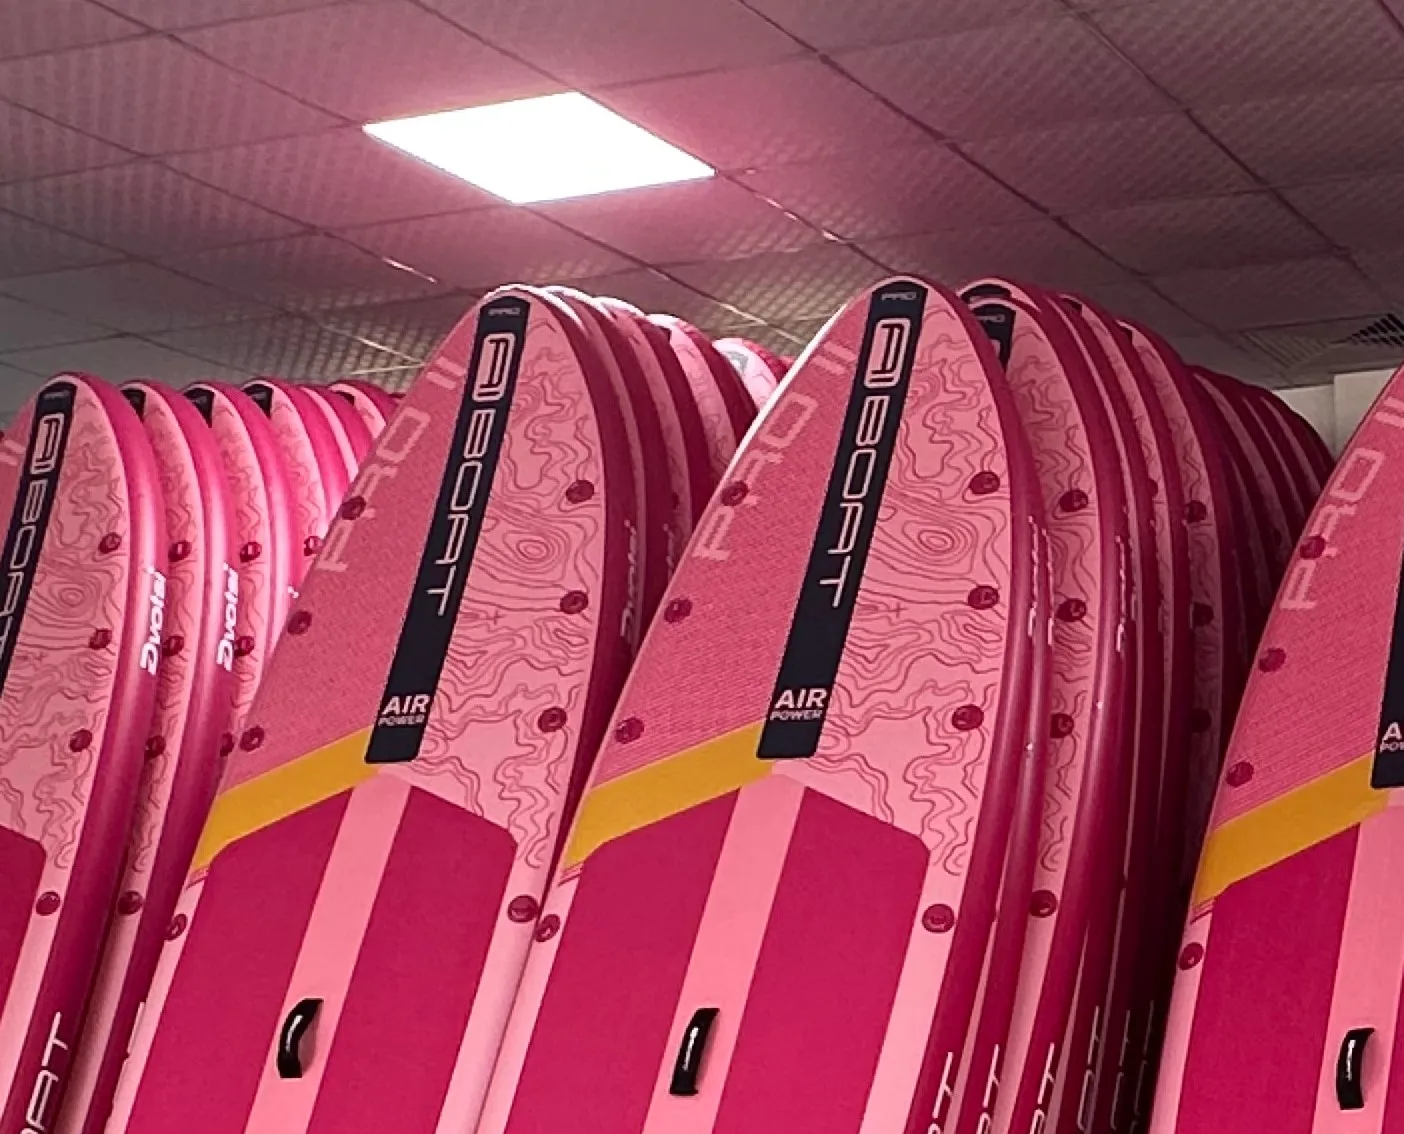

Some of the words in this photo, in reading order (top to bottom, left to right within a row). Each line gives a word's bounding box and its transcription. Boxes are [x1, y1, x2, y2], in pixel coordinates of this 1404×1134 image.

[382, 693, 430, 715] AIR
[775, 688, 827, 708] AIR
[770, 709, 822, 721] POWER
